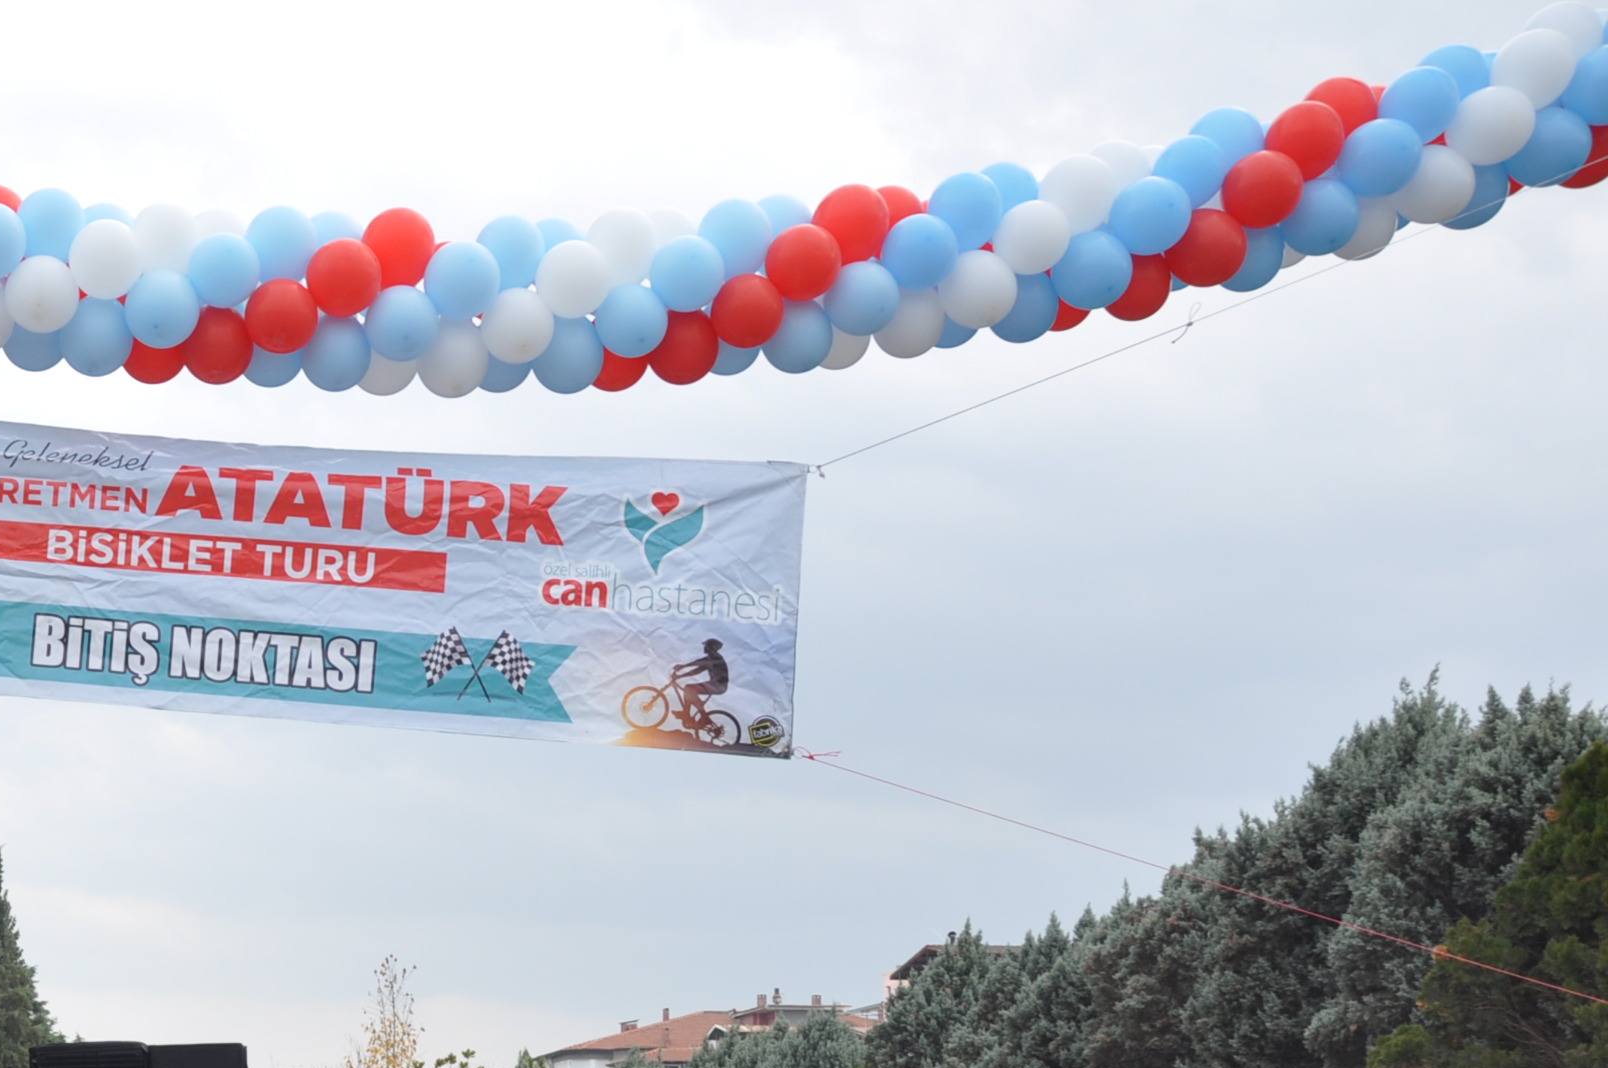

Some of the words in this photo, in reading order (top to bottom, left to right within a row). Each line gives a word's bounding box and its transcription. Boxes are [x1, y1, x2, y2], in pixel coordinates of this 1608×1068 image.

[3, 438, 154, 473] Geleneksel
[154, 465, 568, 546] ATATÜRK
[256, 543, 376, 584] TURU
[543, 561, 571, 578] özel
[575, 563, 612, 580] salihli
[168, 625, 377, 694] NOKTASI
